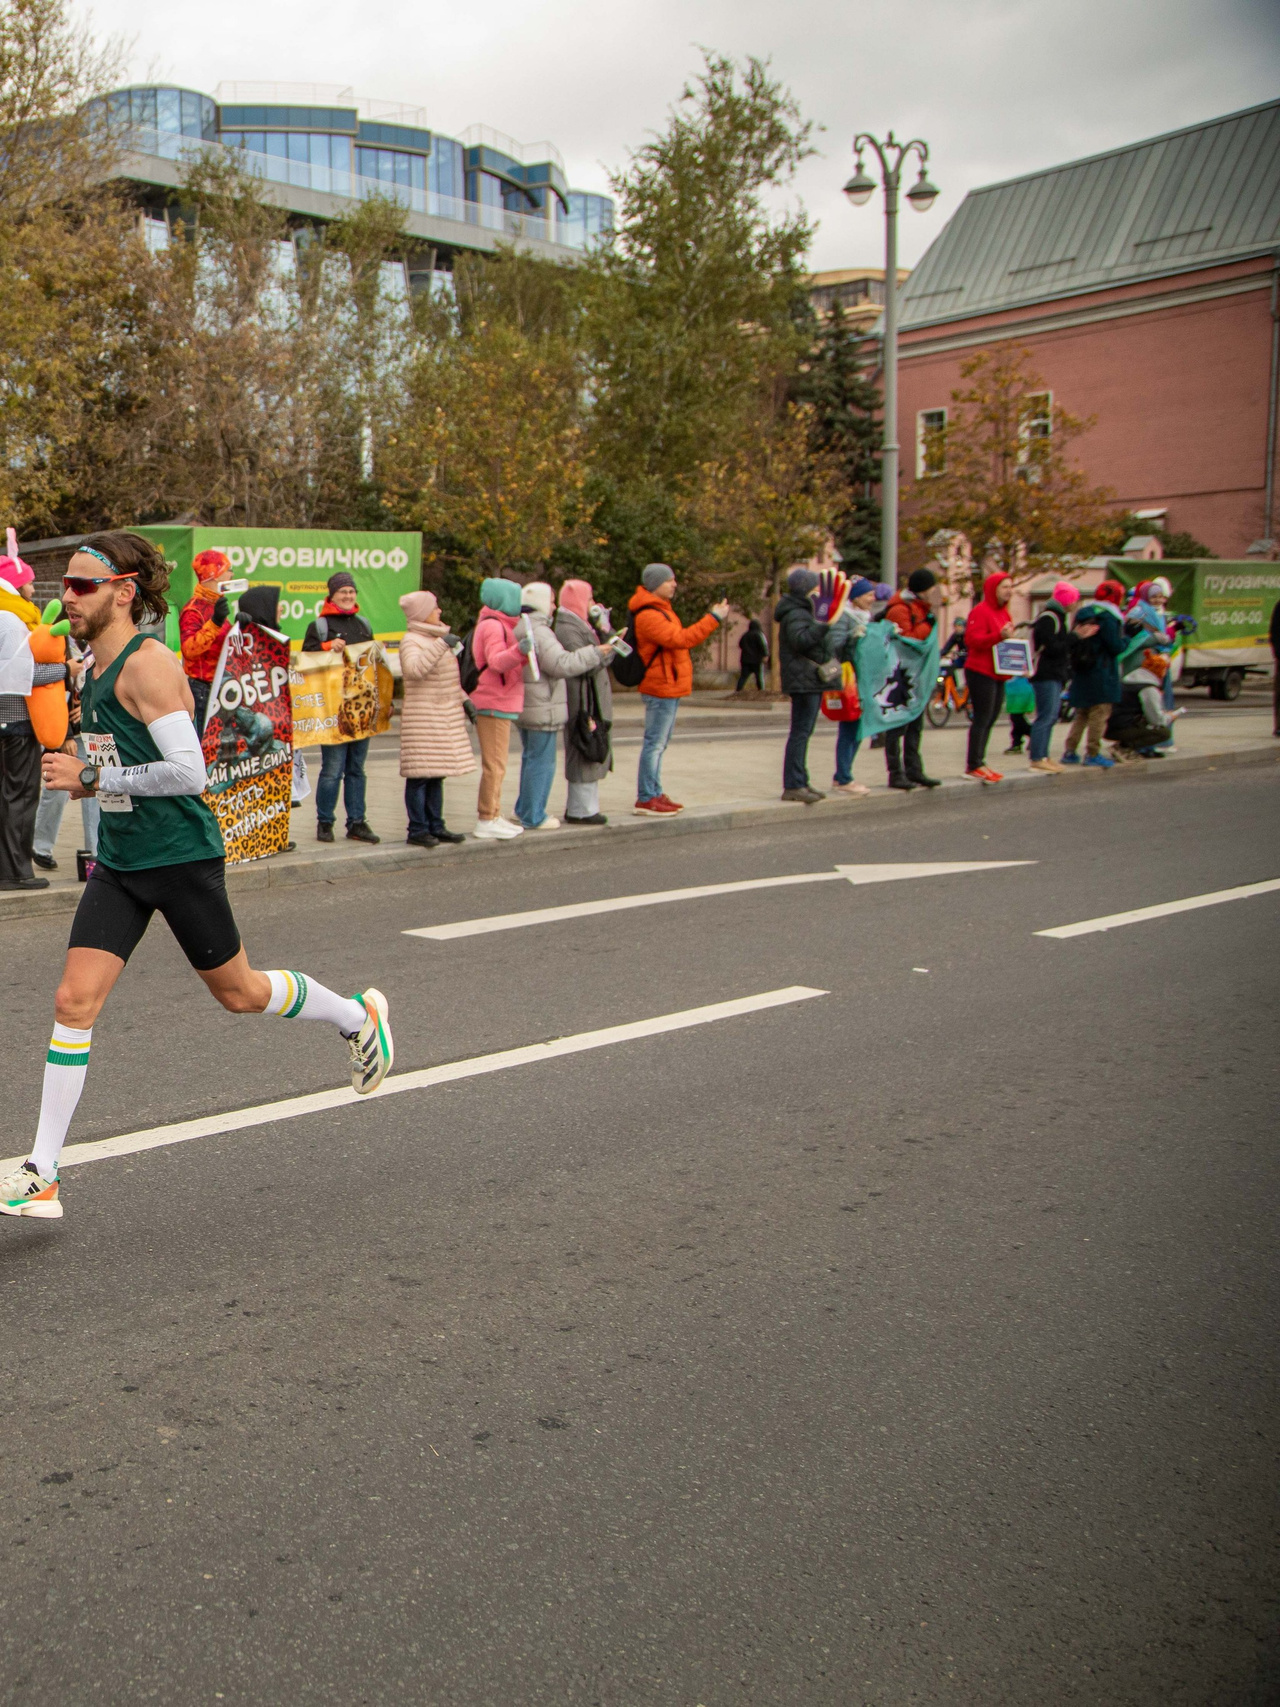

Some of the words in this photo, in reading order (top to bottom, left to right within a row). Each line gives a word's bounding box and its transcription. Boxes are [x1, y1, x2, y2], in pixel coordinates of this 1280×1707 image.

[293, 692, 325, 709] СТРЕЕ
[230, 756, 260, 780] МНЕ
[262, 742, 292, 770] СИЛ!
[217, 784, 264, 817] СТАТЬ
[224, 801, 286, 842] ОПАРДОМ
